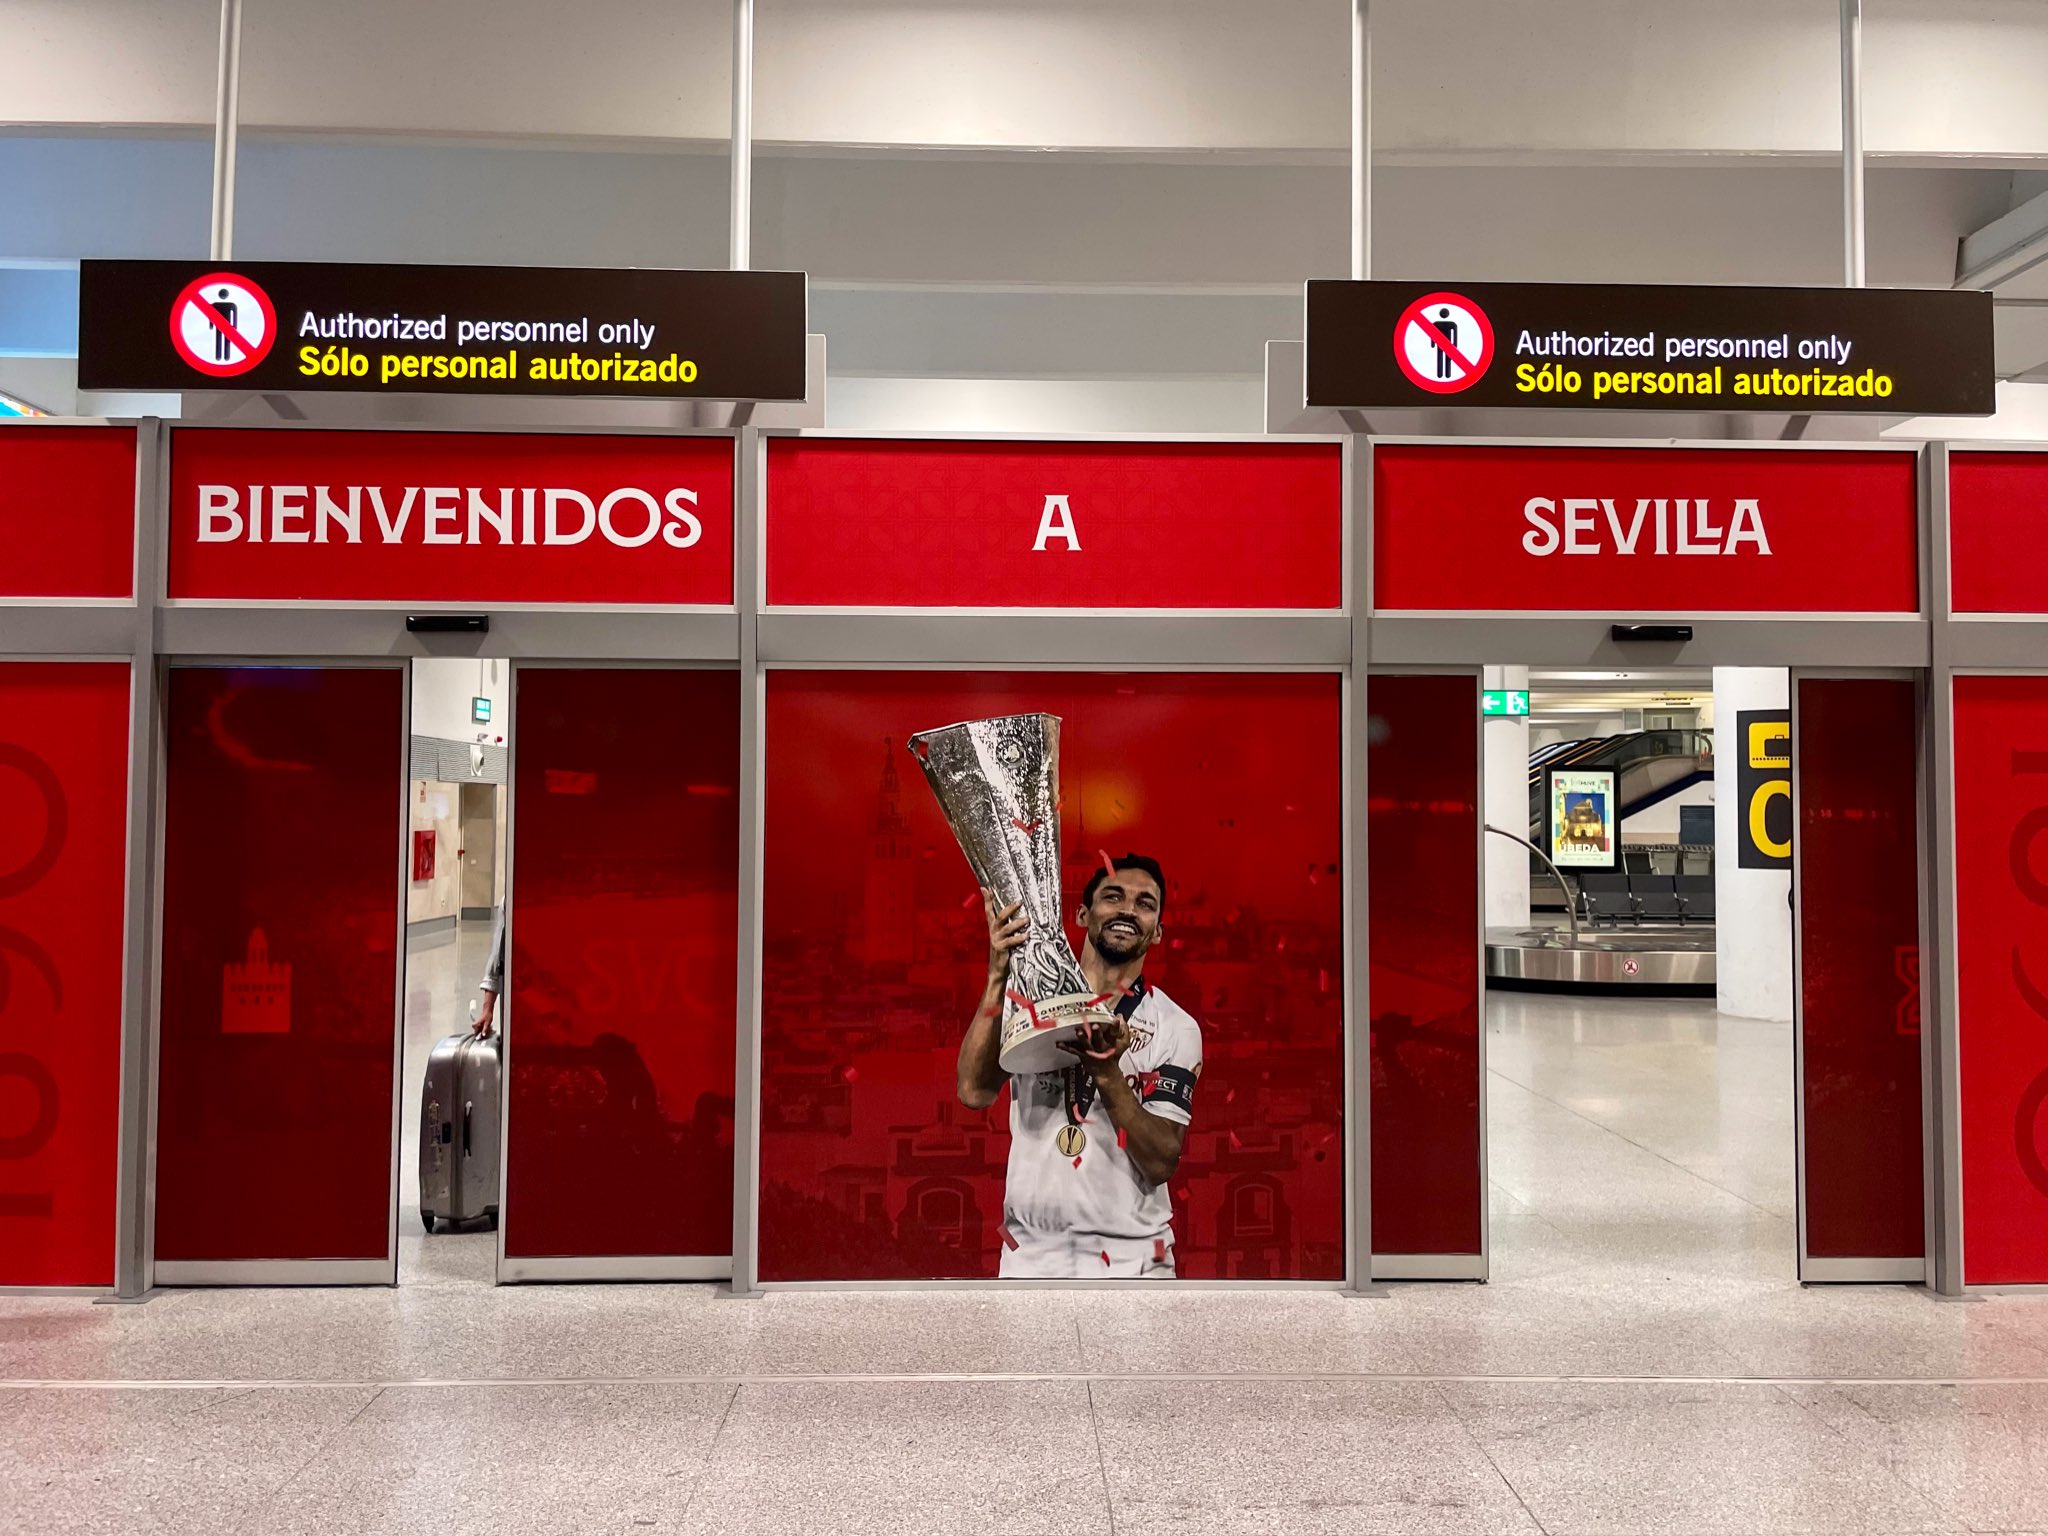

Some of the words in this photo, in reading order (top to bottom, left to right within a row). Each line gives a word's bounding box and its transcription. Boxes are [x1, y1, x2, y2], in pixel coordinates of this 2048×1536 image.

[299, 311, 447, 340] Authorized
[457, 317, 588, 347] personnel
[598, 318, 656, 350] only
[1515, 329, 1655, 357] Authorized
[1665, 333, 1789, 363] personnel
[1797, 334, 1852, 366] only
[298, 345, 370, 377] Sólo
[381, 349, 517, 384] personal
[529, 352, 699, 383] autorizado
[1515, 362, 1582, 393] Sólo
[1593, 366, 1722, 400] personal
[1733, 367, 1893, 398] autorizado
[196, 484, 703, 548] BIENVENIDOS
[1031, 494, 1083, 551] A
[1522, 497, 1773, 557] SEVILLA
